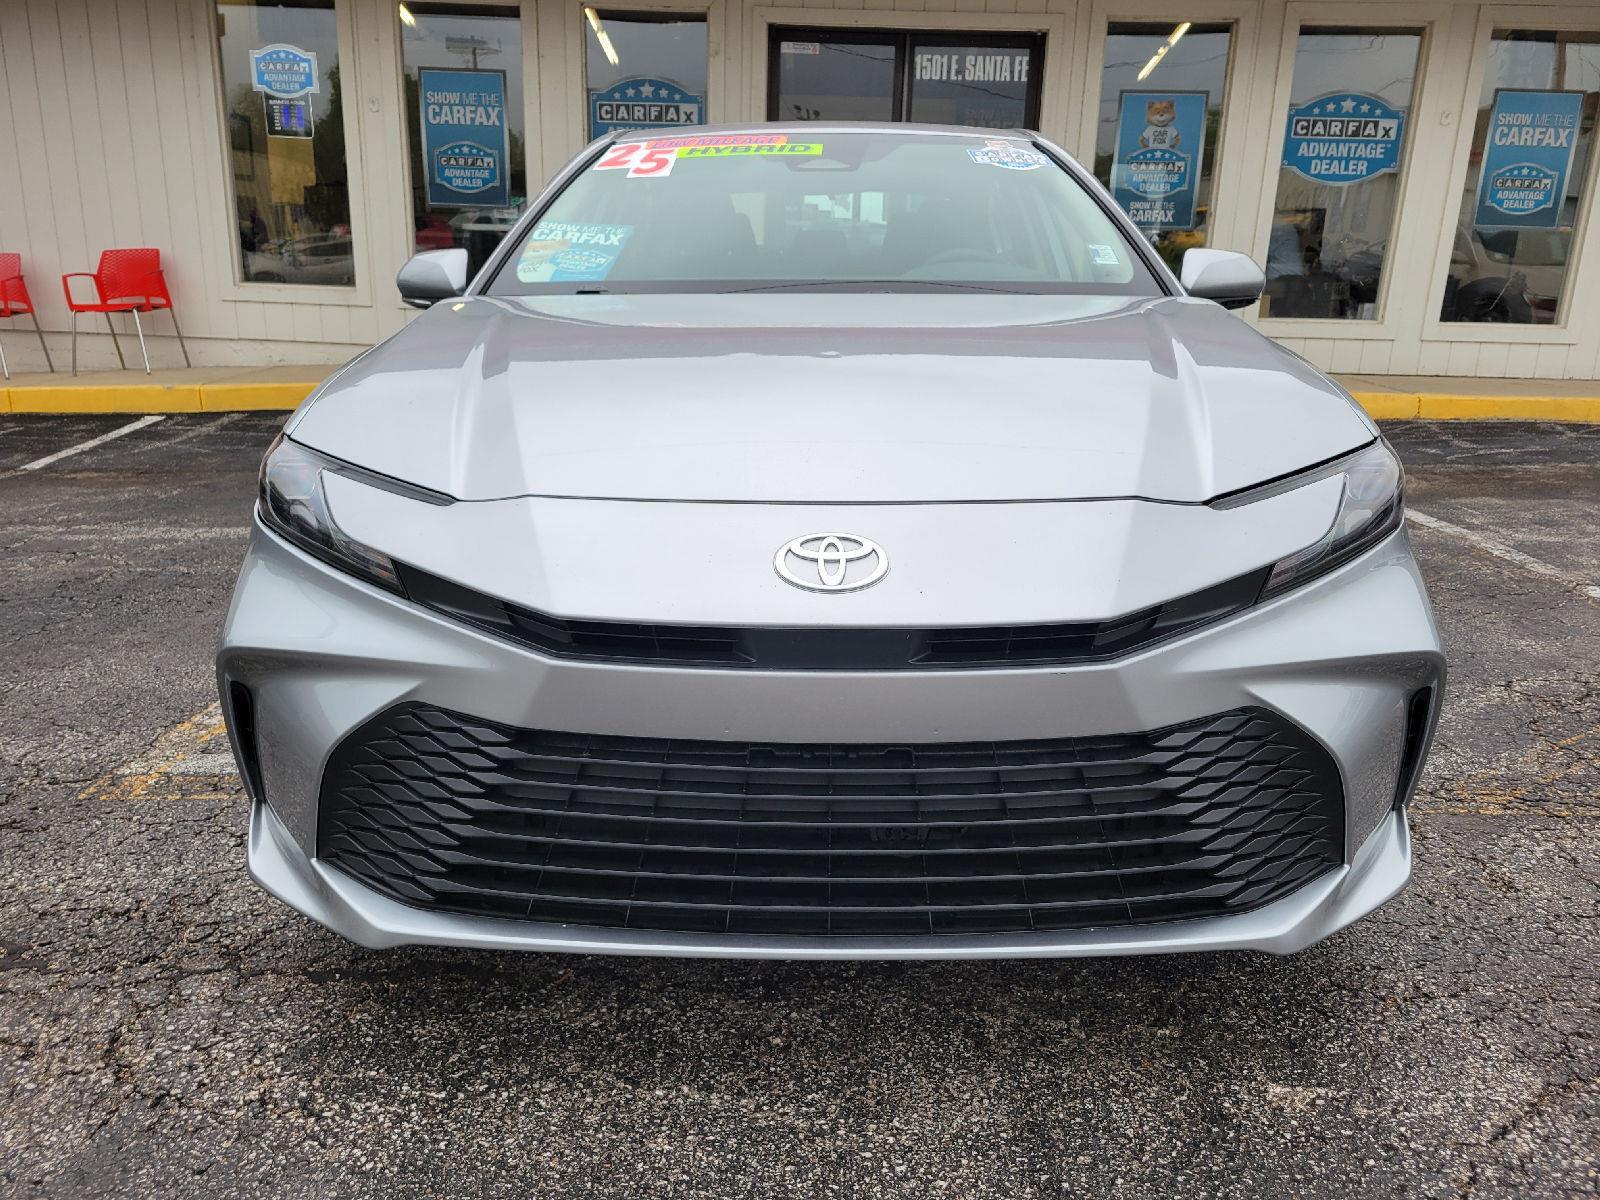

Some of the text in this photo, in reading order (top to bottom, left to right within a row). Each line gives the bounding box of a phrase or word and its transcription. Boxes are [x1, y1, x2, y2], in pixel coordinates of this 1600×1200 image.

[260, 63, 309, 73] CARFAX
[914, 54, 1030, 82] 1501 E. SANTA FE
[264, 73, 306, 82] ADVANTAGE
[272, 82, 300, 90] DEALER
[426, 91, 499, 106] SHOW ME THE
[427, 105, 500, 126] CARFAX
[600, 105, 694, 123] CARFAX
[1497, 113, 1575, 127] SHOW ME THE
[1153, 130, 1169, 138] CAR
[1296, 120, 1392, 139] CARFAX
[1494, 126, 1570, 148] CARFAX
[687, 144, 811, 155] HYBRID
[1297, 142, 1386, 158] ADVANTAGE
[440, 157, 494, 168] CARFAX
[1131, 162, 1184, 173] CARFAX
[1310, 160, 1368, 175] DEALER
[444, 168, 490, 178] ADVANTAGE
[1132, 173, 1180, 183] ADVANTAGE
[452, 178, 482, 187] DEALER
[1140, 182, 1171, 191] DEALER
[1496, 179, 1551, 190] CARFAX
[1497, 190, 1545, 200] ADVANTAGE
[1129, 201, 1151, 209] SHOW
[1503, 200, 1535, 209] DEALER
[1128, 209, 1176, 222] CARFAX
[538, 221, 580, 232] SHOW
[532, 228, 624, 246] CARFAX
